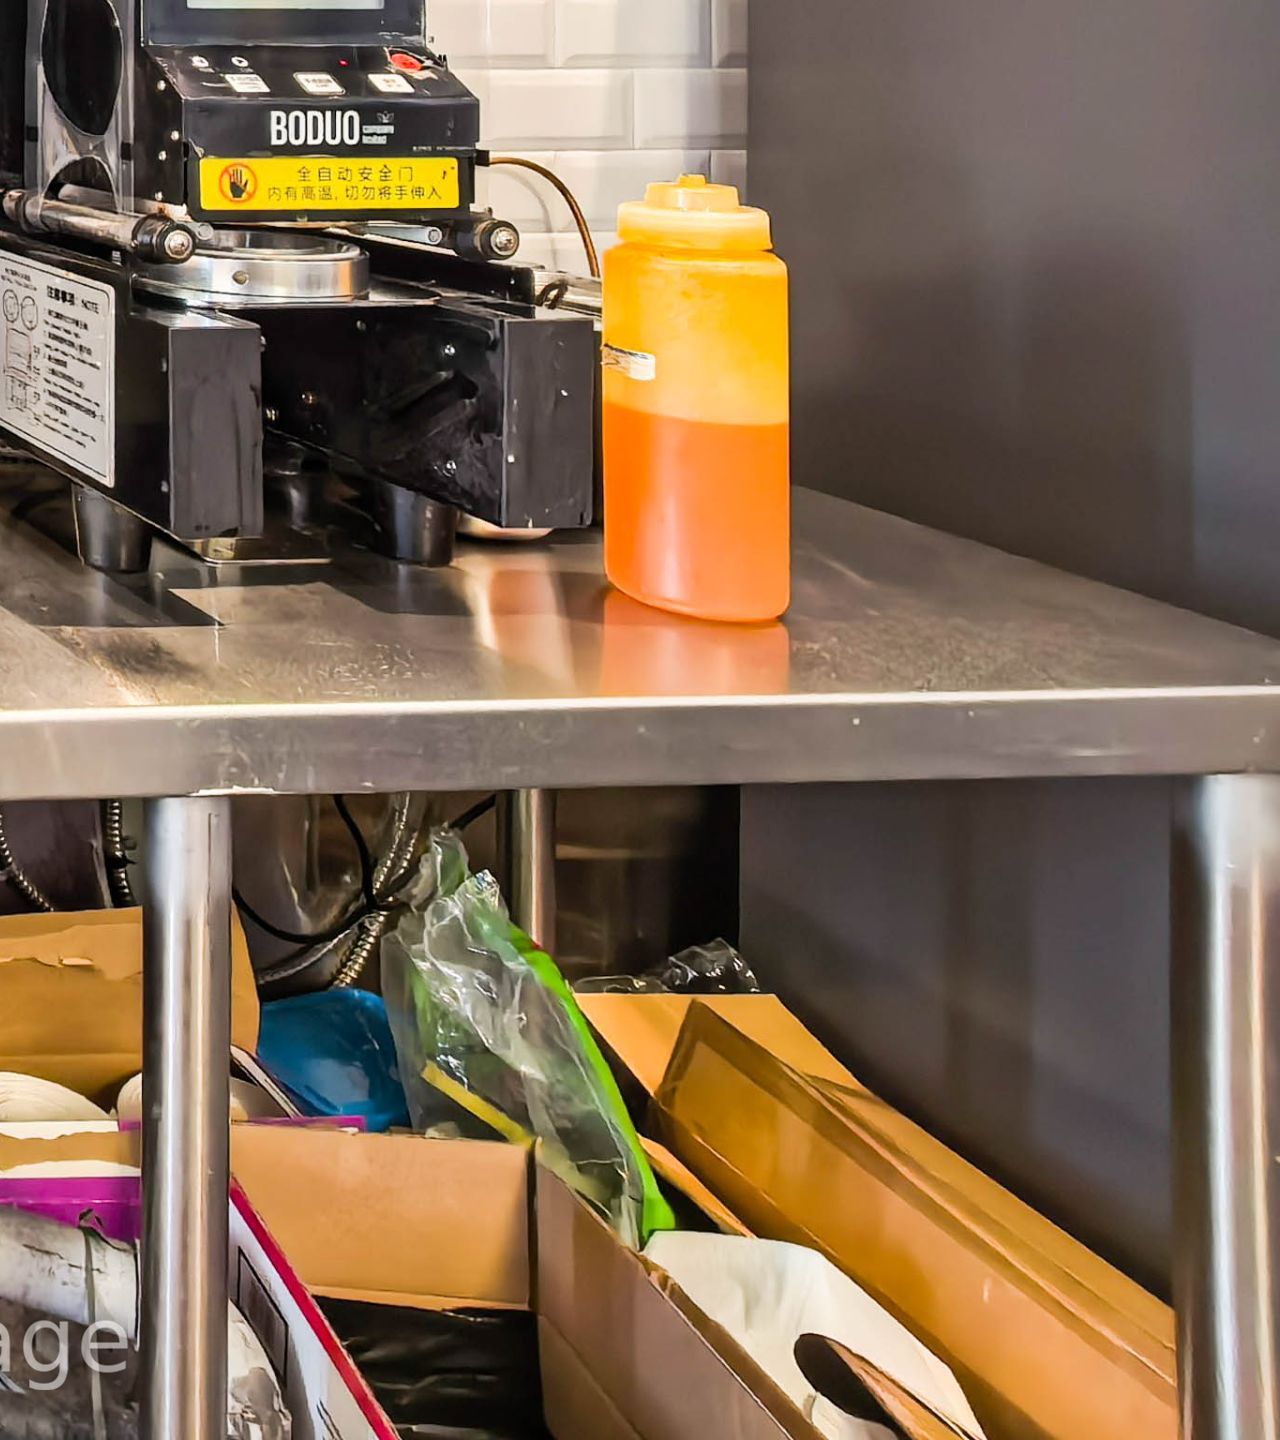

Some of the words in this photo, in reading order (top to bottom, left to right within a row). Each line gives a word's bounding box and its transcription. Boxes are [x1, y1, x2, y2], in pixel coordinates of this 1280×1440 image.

[270, 110, 360, 146] BODUO
[297, 166, 414, 182] 全自动安全门
